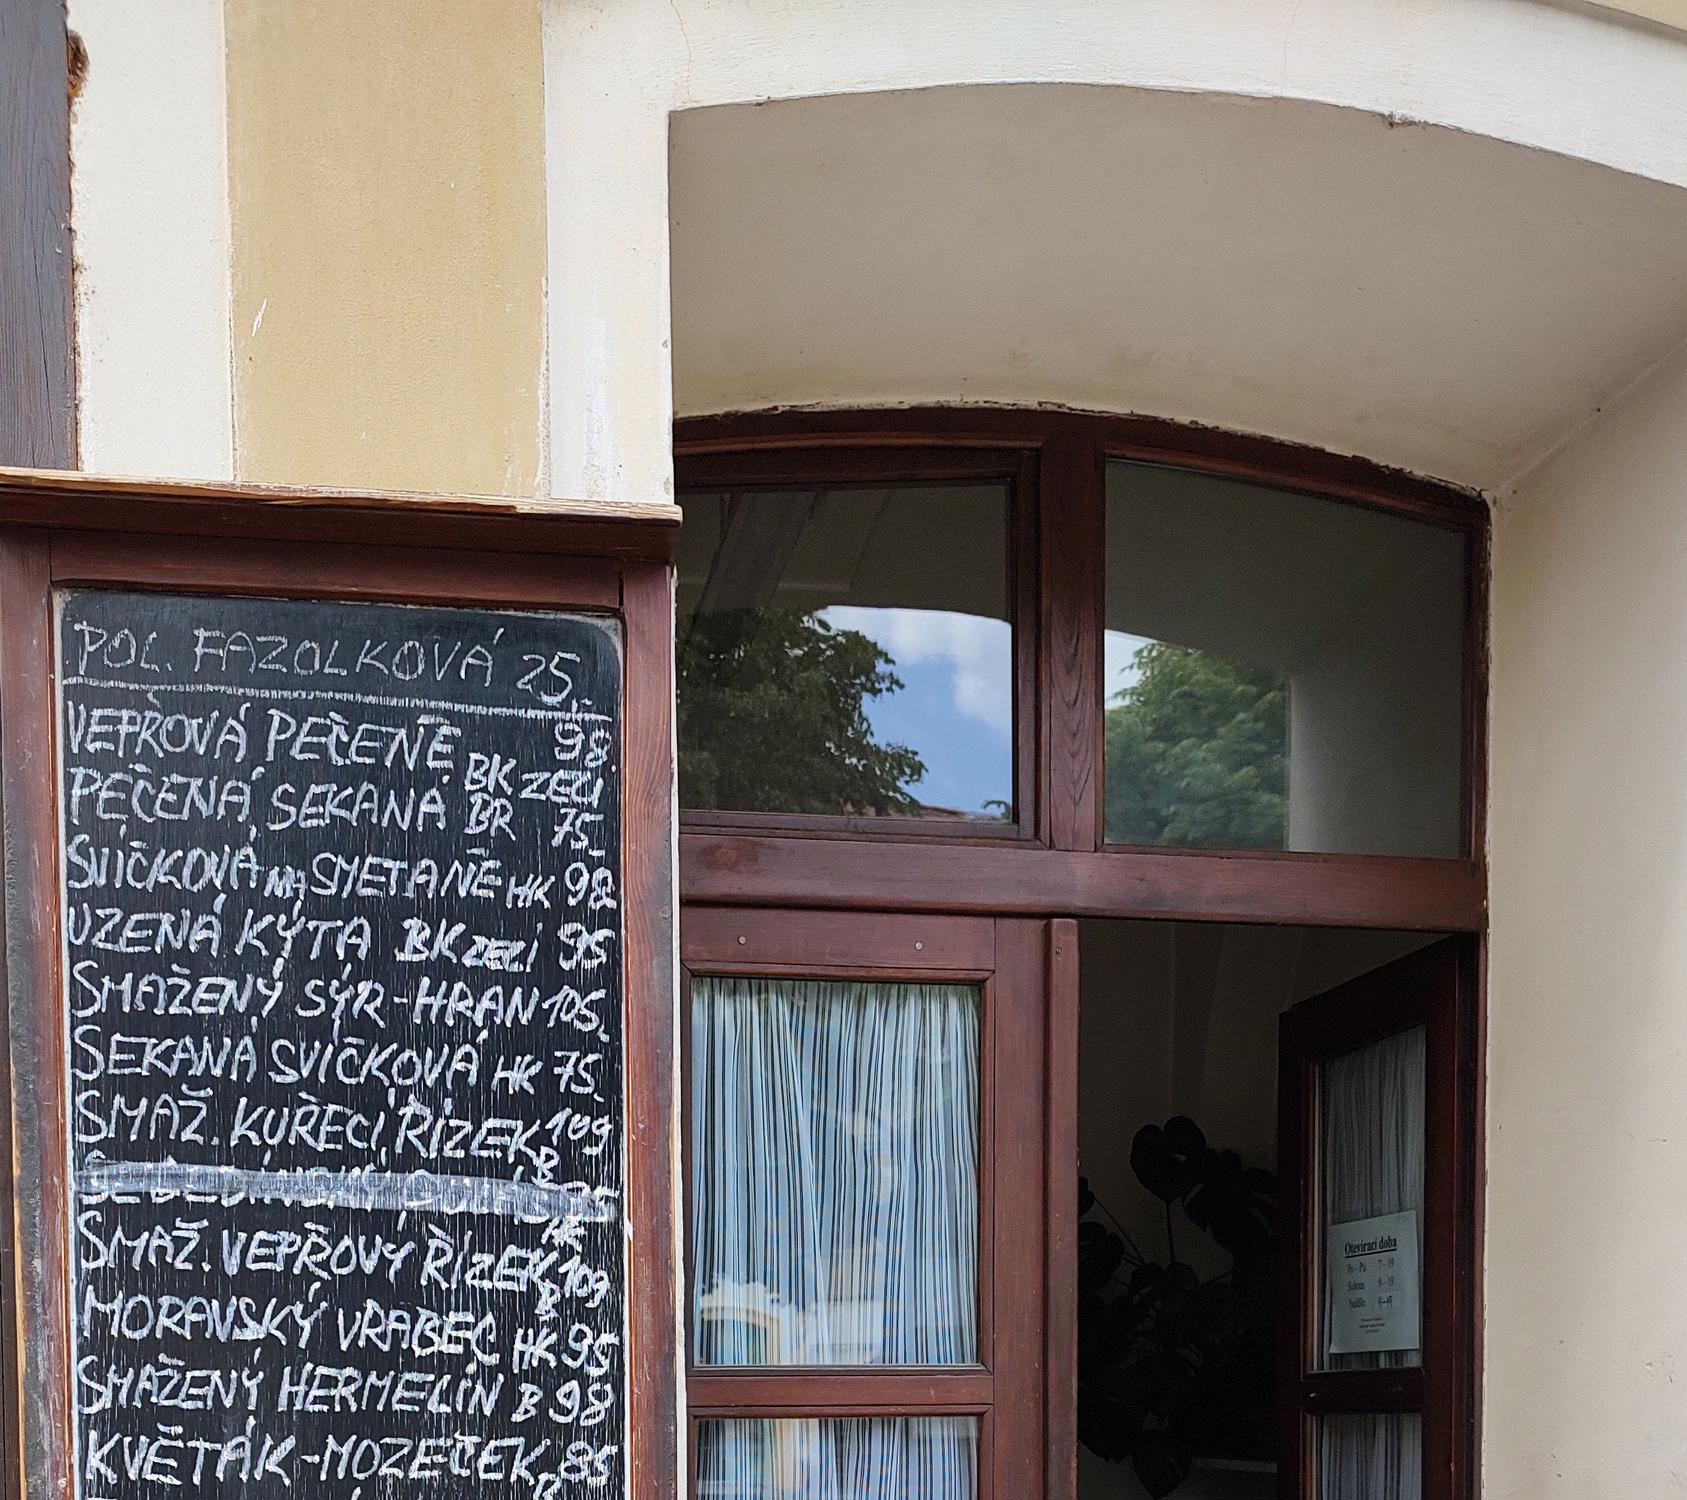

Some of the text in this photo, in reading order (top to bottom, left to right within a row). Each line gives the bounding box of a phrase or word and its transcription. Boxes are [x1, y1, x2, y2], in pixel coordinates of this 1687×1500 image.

[193, 628, 504, 686] FAZOLKOVÁ
[68, 692, 250, 763] VEPŘOVÁ
[67, 763, 265, 826] PEČENÁ
[464, 791, 517, 841] BR
[68, 824, 260, 892] SVÍČKOVÁ
[505, 873, 556, 909] HK
[563, 861, 617, 910] 98
[67, 892, 226, 957] UZENÁ
[235, 900, 371, 961] KÝTA
[394, 916, 467, 963] BK
[71, 957, 284, 1018] SMAŽENÝ
[72, 1015, 258, 1082] SEKANÁ
[268, 1018, 488, 1089] SVÍČKOVÁ
[76, 1083, 219, 1146] SMAŽ.
[395, 1093, 540, 1164] ŘÍZEK
[222, 1211, 416, 1283] VEPŘOVÝ
[421, 1222, 557, 1292] ŘÍZEK
[1379, 1235, 1397, 1249] doba
[83, 1281, 328, 1349] MORAVSKÝ
[338, 1298, 500, 1367] VRABEC
[77, 1346, 264, 1415] SMAŽENÝ
[511, 1382, 544, 1423] B
[548, 1379, 615, 1427] 98
